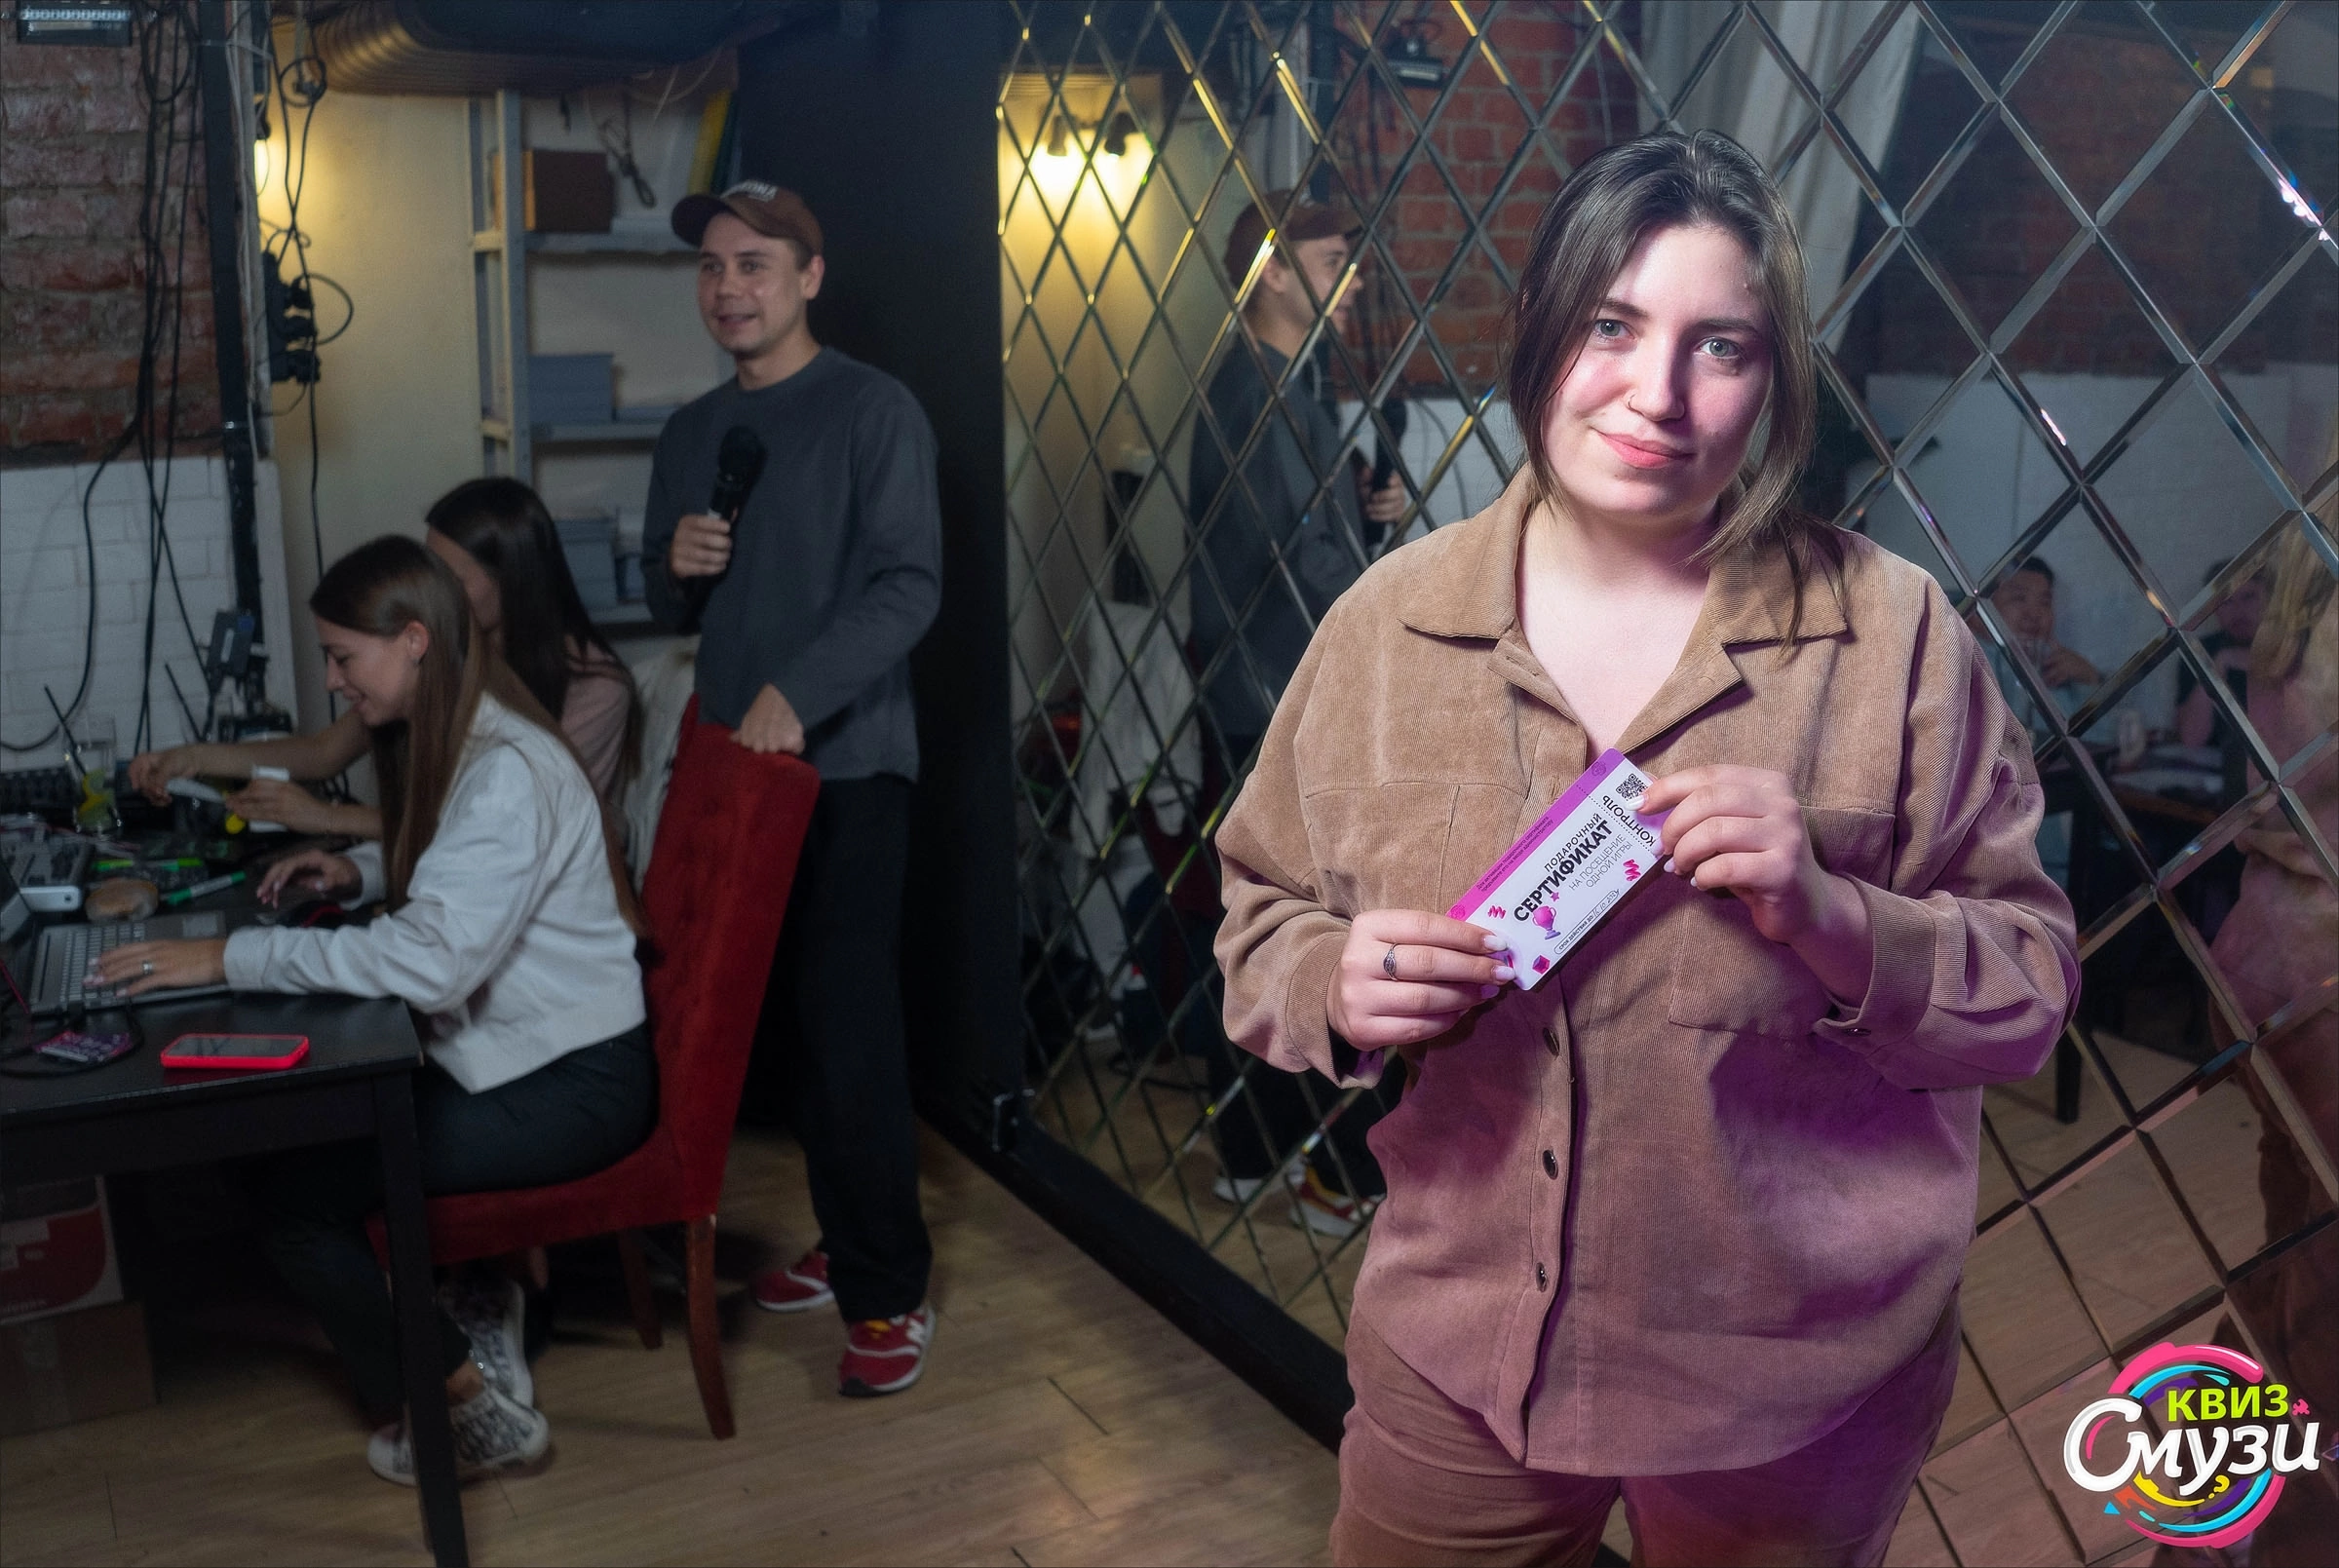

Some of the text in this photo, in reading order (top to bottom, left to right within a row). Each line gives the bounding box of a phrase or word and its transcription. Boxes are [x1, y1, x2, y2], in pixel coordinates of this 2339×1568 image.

[1545, 813, 1601, 871] ПОДАРОЧНЫЙ
[1603, 795, 1655, 846] КОНТРОЛЬ
[1515, 820, 1611, 920] СЕРТИФИКАТ
[1568, 834, 1626, 891] НА ПОСЕЩЕНИЕ
[1587, 841, 1632, 887] ОДНОЙ ИГРЫ
[1559, 939, 1569, 949] СРОК
[1569, 921, 1587, 940] ДЕЙСТВИЯ
